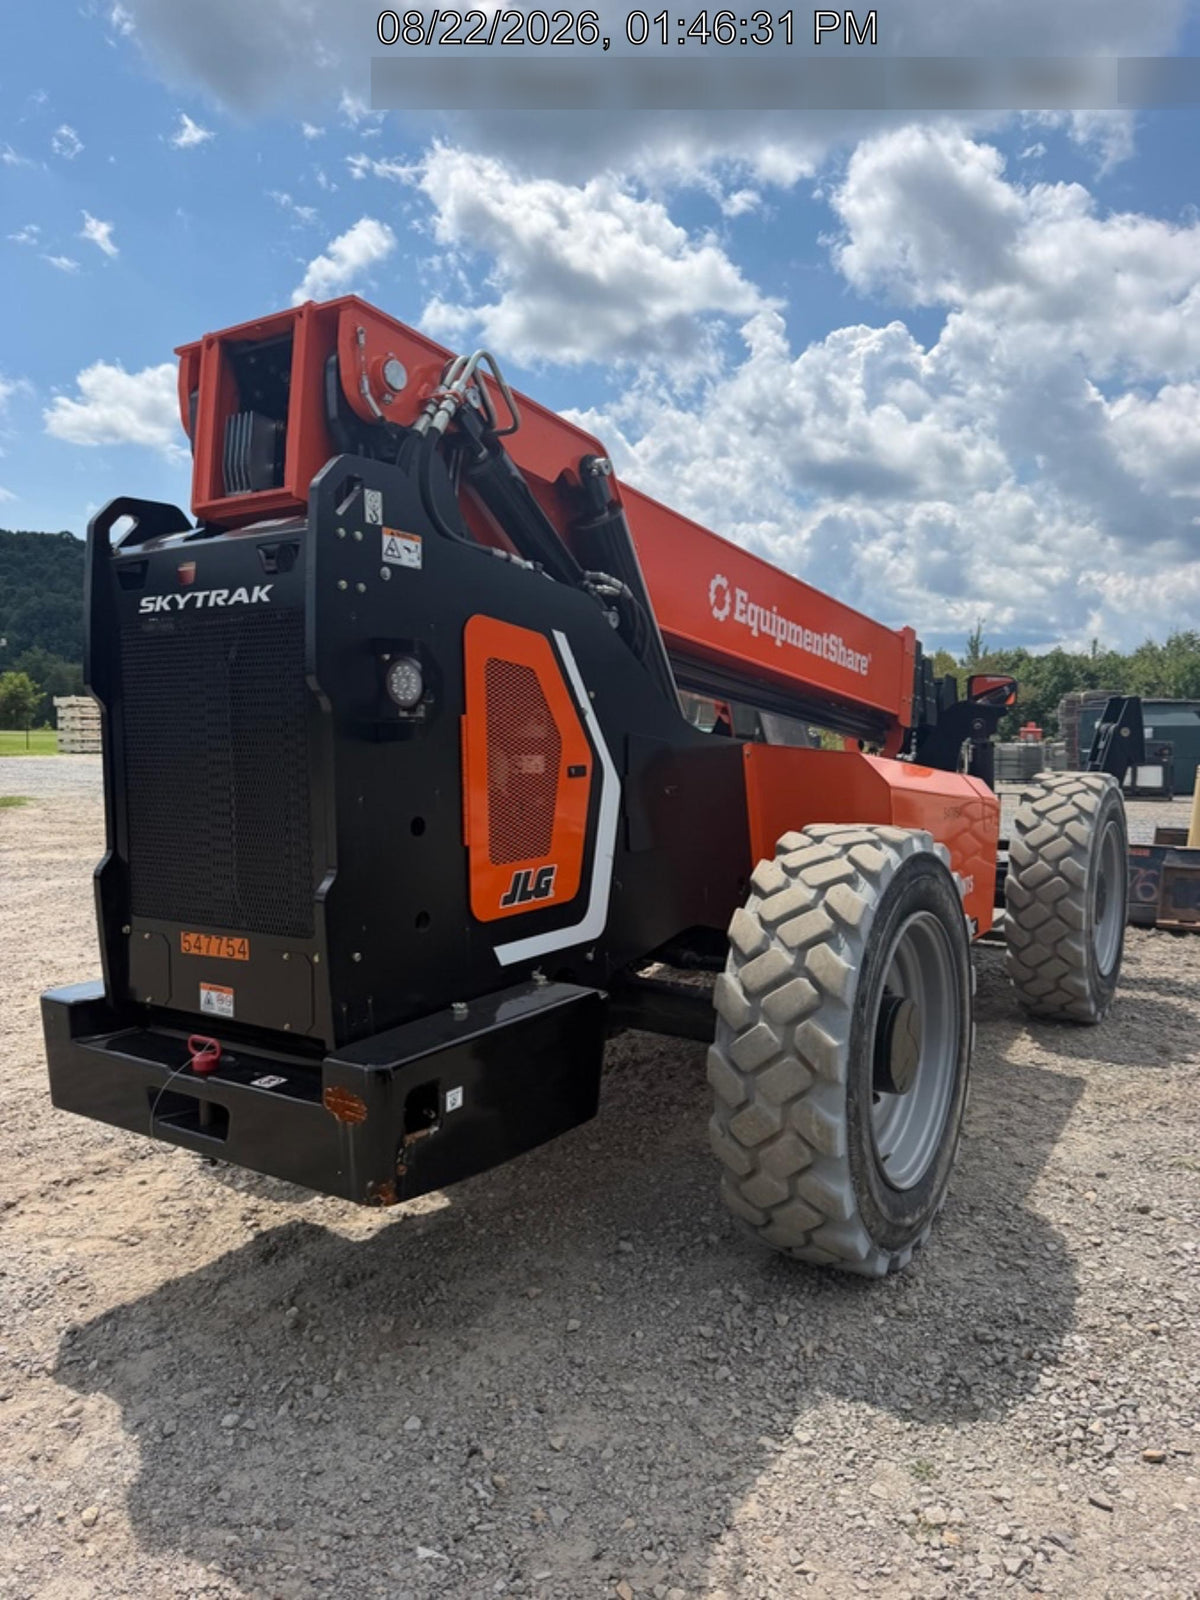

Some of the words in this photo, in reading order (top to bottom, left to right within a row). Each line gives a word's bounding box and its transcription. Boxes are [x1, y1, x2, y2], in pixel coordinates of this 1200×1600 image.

[138, 584, 274, 614] SKYTRAK
[734, 587, 869, 676] EquipmentShare
[499, 864, 558, 909] JLG
[181, 932, 248, 959] 547754
